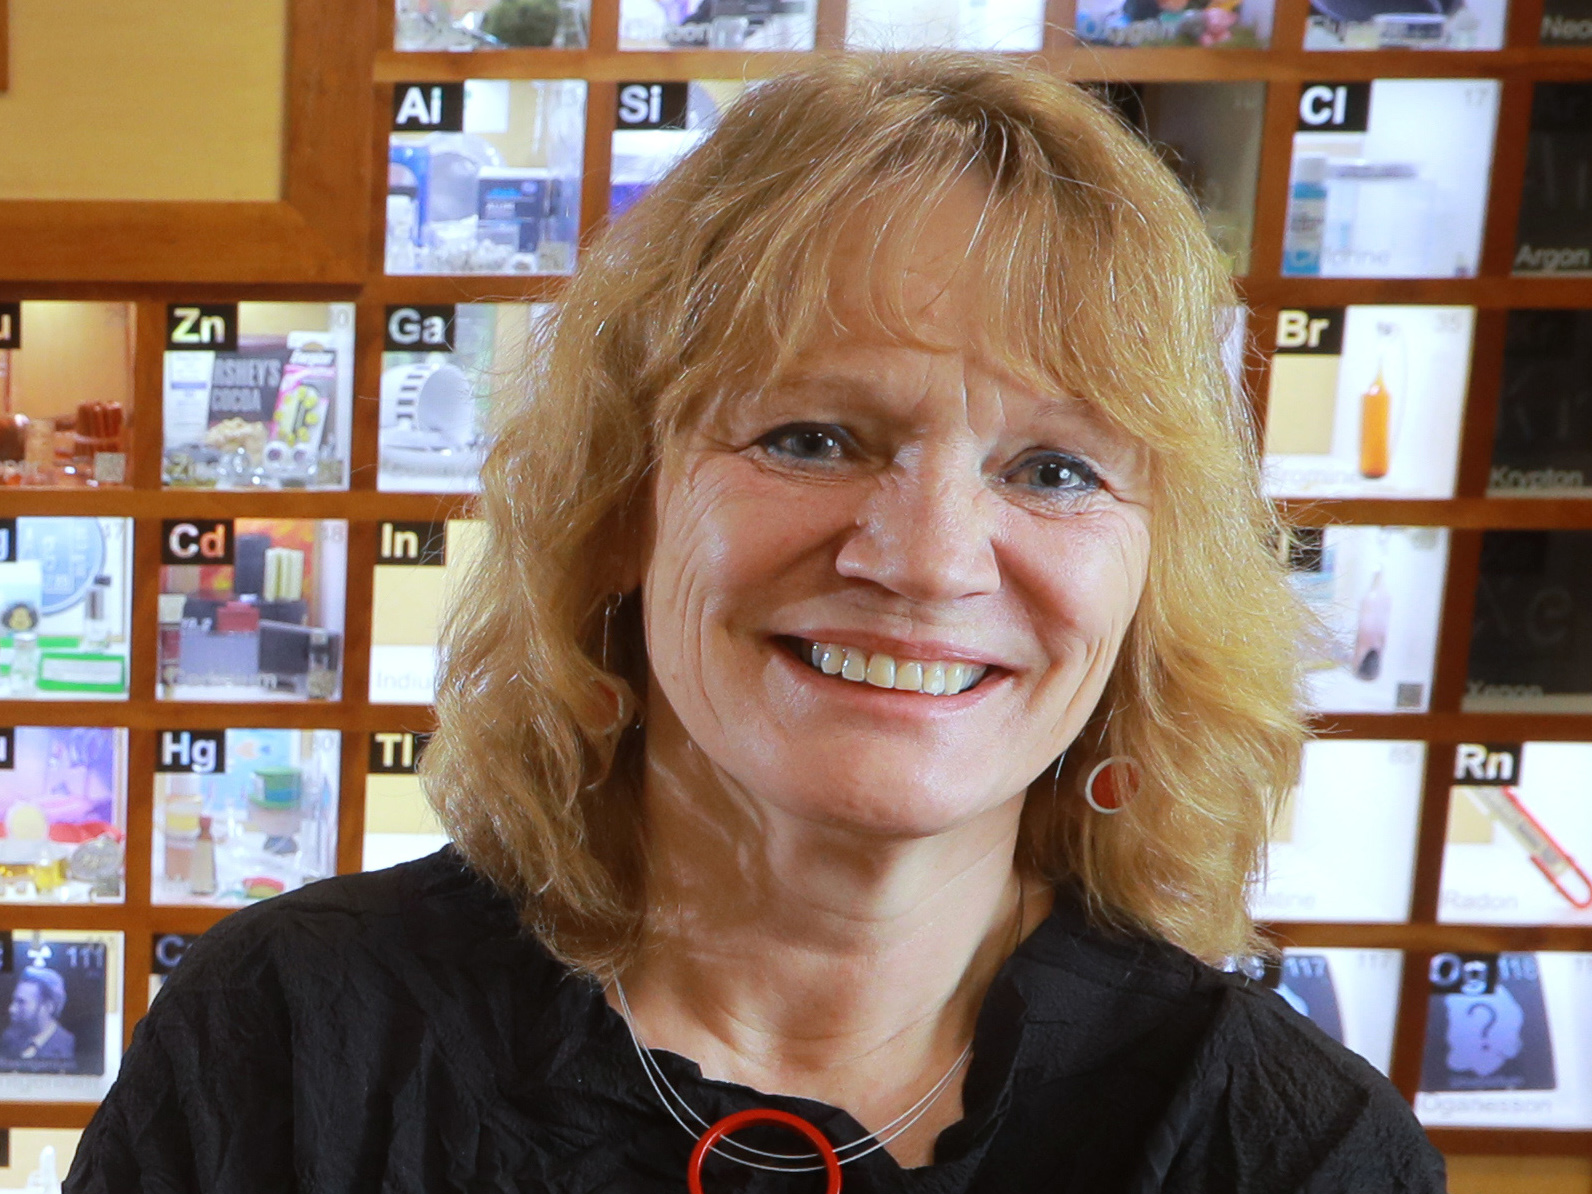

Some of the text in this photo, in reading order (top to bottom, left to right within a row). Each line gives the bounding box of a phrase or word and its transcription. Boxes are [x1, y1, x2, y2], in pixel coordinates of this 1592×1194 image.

[1541, 13, 1592, 39] Neo
[618, 85, 663, 124] Si
[1299, 85, 1348, 126] Cl
[1513, 243, 1590, 273] Argon
[171, 306, 226, 344] Zn
[388, 308, 446, 345] Ga
[1275, 309, 1331, 349] Br
[1489, 465, 1583, 488] Krypton
[168, 523, 226, 558] Cd
[381, 522, 419, 559] In
[375, 670, 436, 691] Indiu
[162, 731, 217, 772] Hg
[374, 732, 414, 768] Tl
[1453, 742, 1515, 781] Rn
[156, 935, 185, 967] C
[1428, 952, 1488, 995] Og
